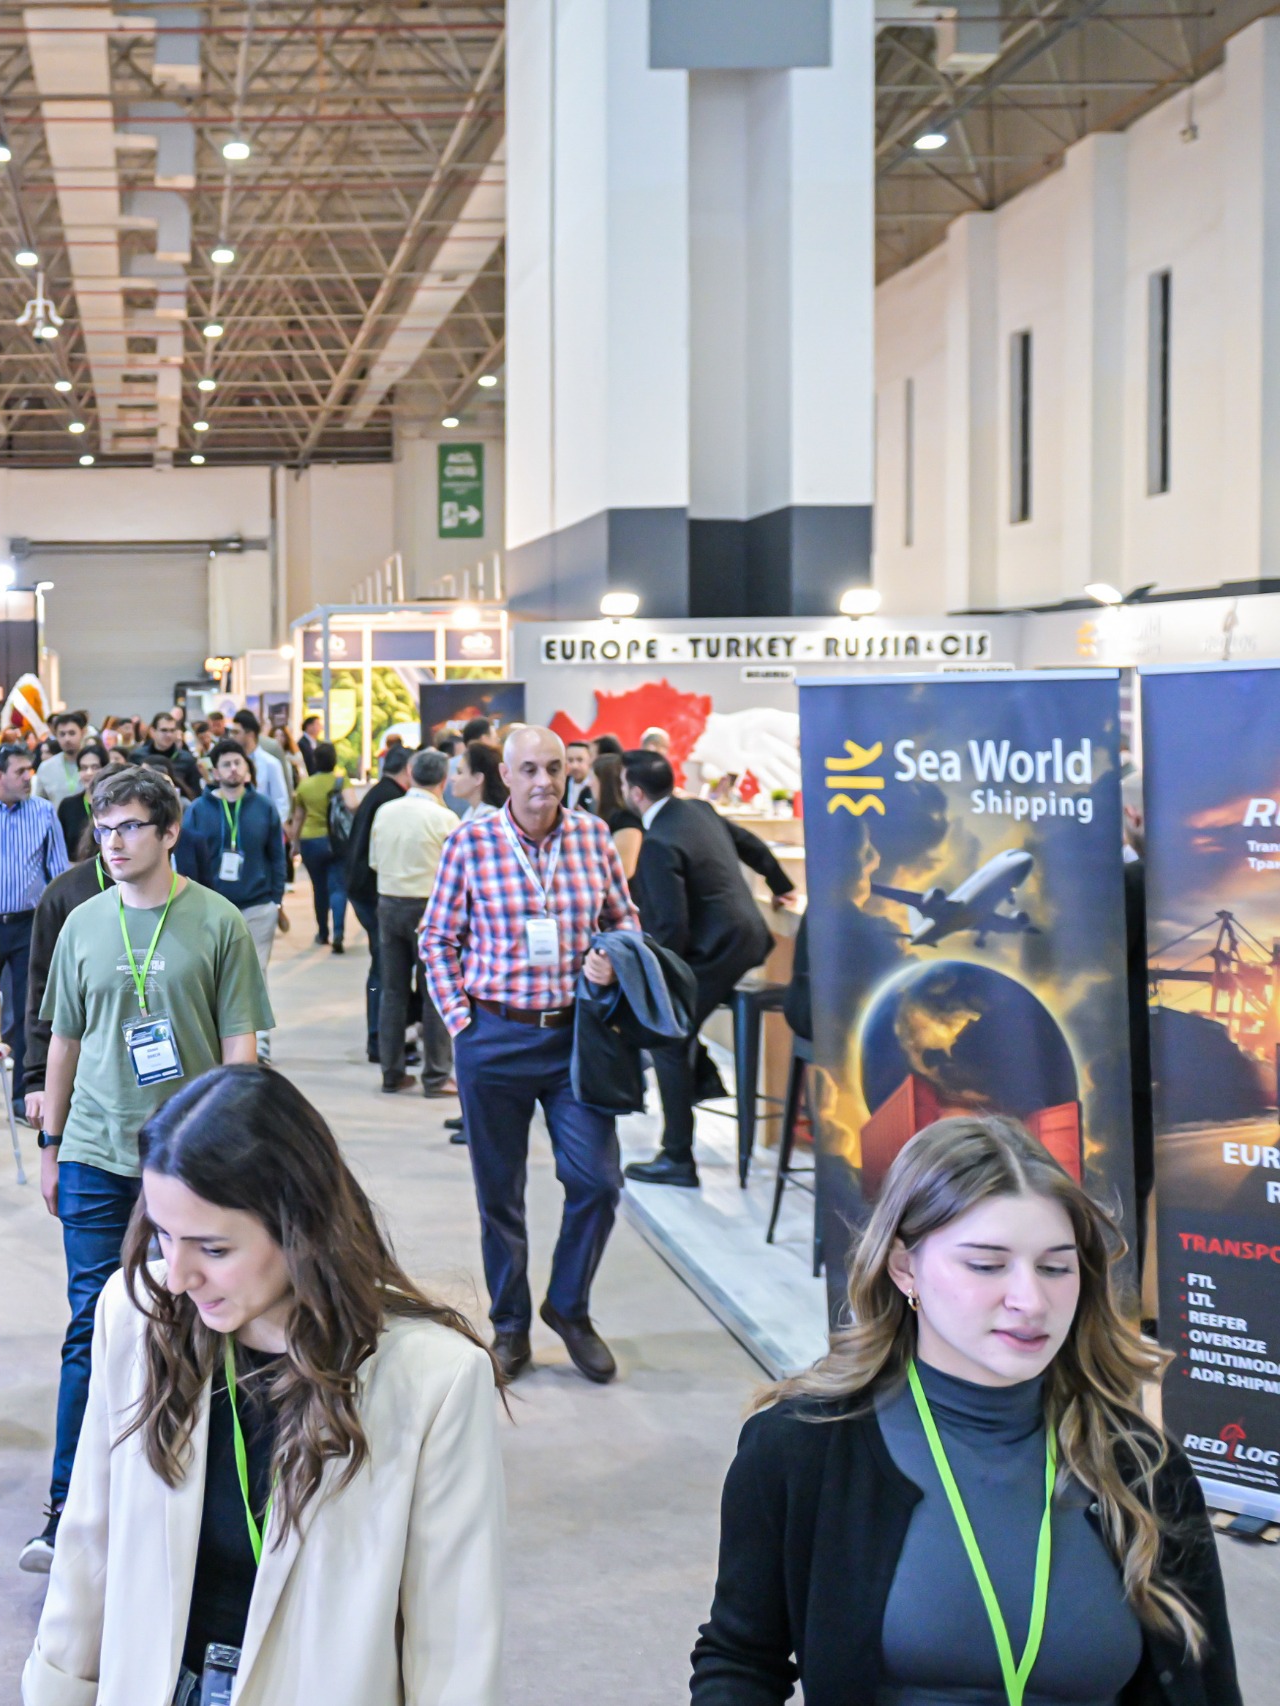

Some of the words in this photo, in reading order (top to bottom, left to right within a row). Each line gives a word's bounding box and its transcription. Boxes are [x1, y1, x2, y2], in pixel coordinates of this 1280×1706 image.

[545, 638, 658, 660] EUROPE
[688, 635, 798, 658] TURKEY
[893, 739, 962, 782] Sea
[968, 738, 1093, 784] World
[971, 789, 1093, 824] Shipping
[1223, 1142, 1280, 1169] EUR
[1187, 1272, 1217, 1290] FTL
[1188, 1291, 1216, 1308] LTL
[1188, 1310, 1248, 1332] REEFER
[1188, 1329, 1268, 1355] OVERSIZE
[1190, 1367, 1225, 1384] ADR
[1226, 1373, 1280, 1394] SHIPM
[1183, 1434, 1228, 1455] RED
[1234, 1444, 1280, 1466] LOG
